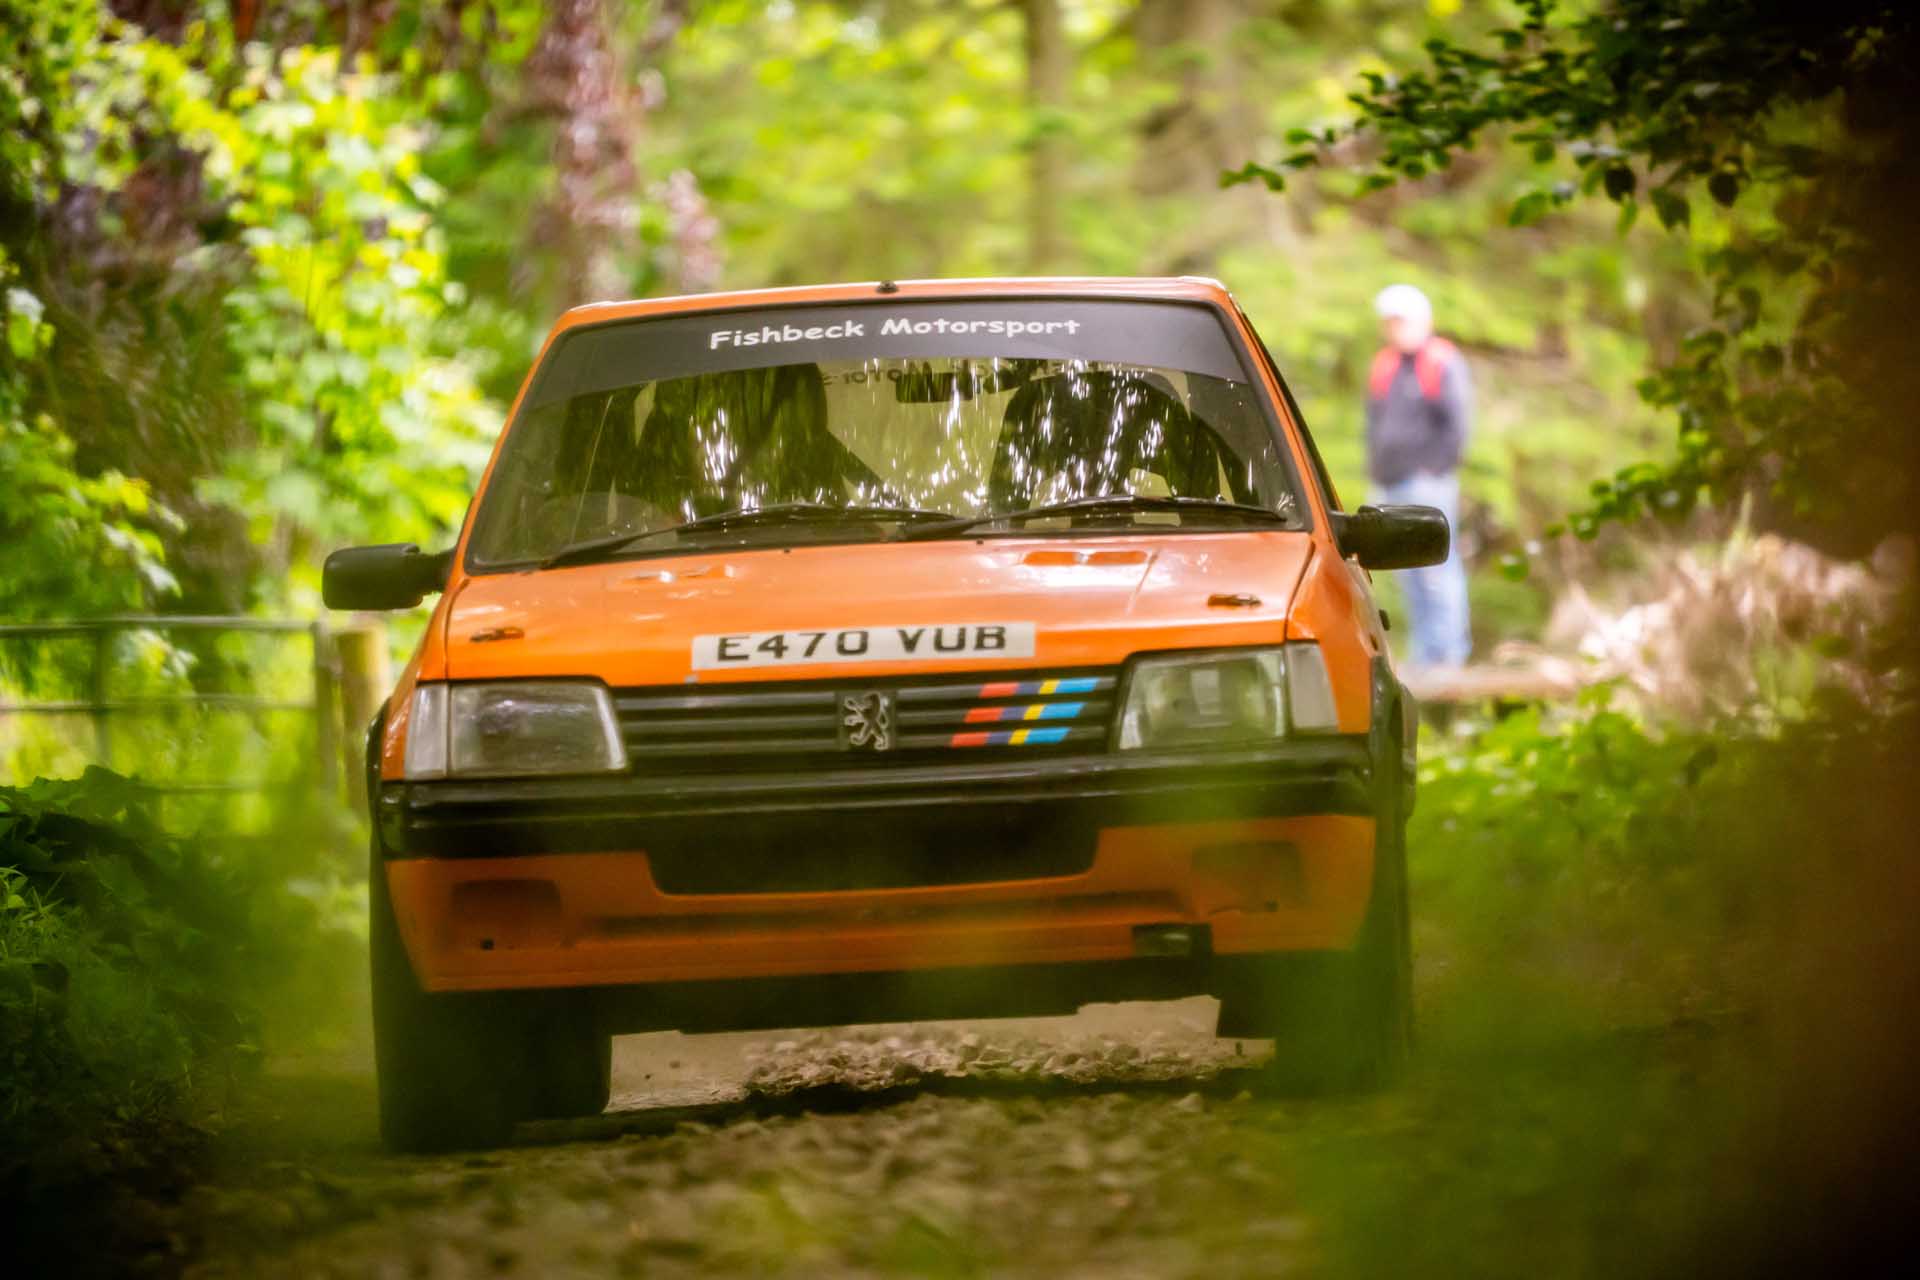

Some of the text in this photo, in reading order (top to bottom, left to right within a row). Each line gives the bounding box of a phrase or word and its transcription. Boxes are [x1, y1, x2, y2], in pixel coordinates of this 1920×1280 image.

[710, 318, 1081, 350] Fishbeck Motorsport
[717, 626, 1006, 662] E470 VUB
